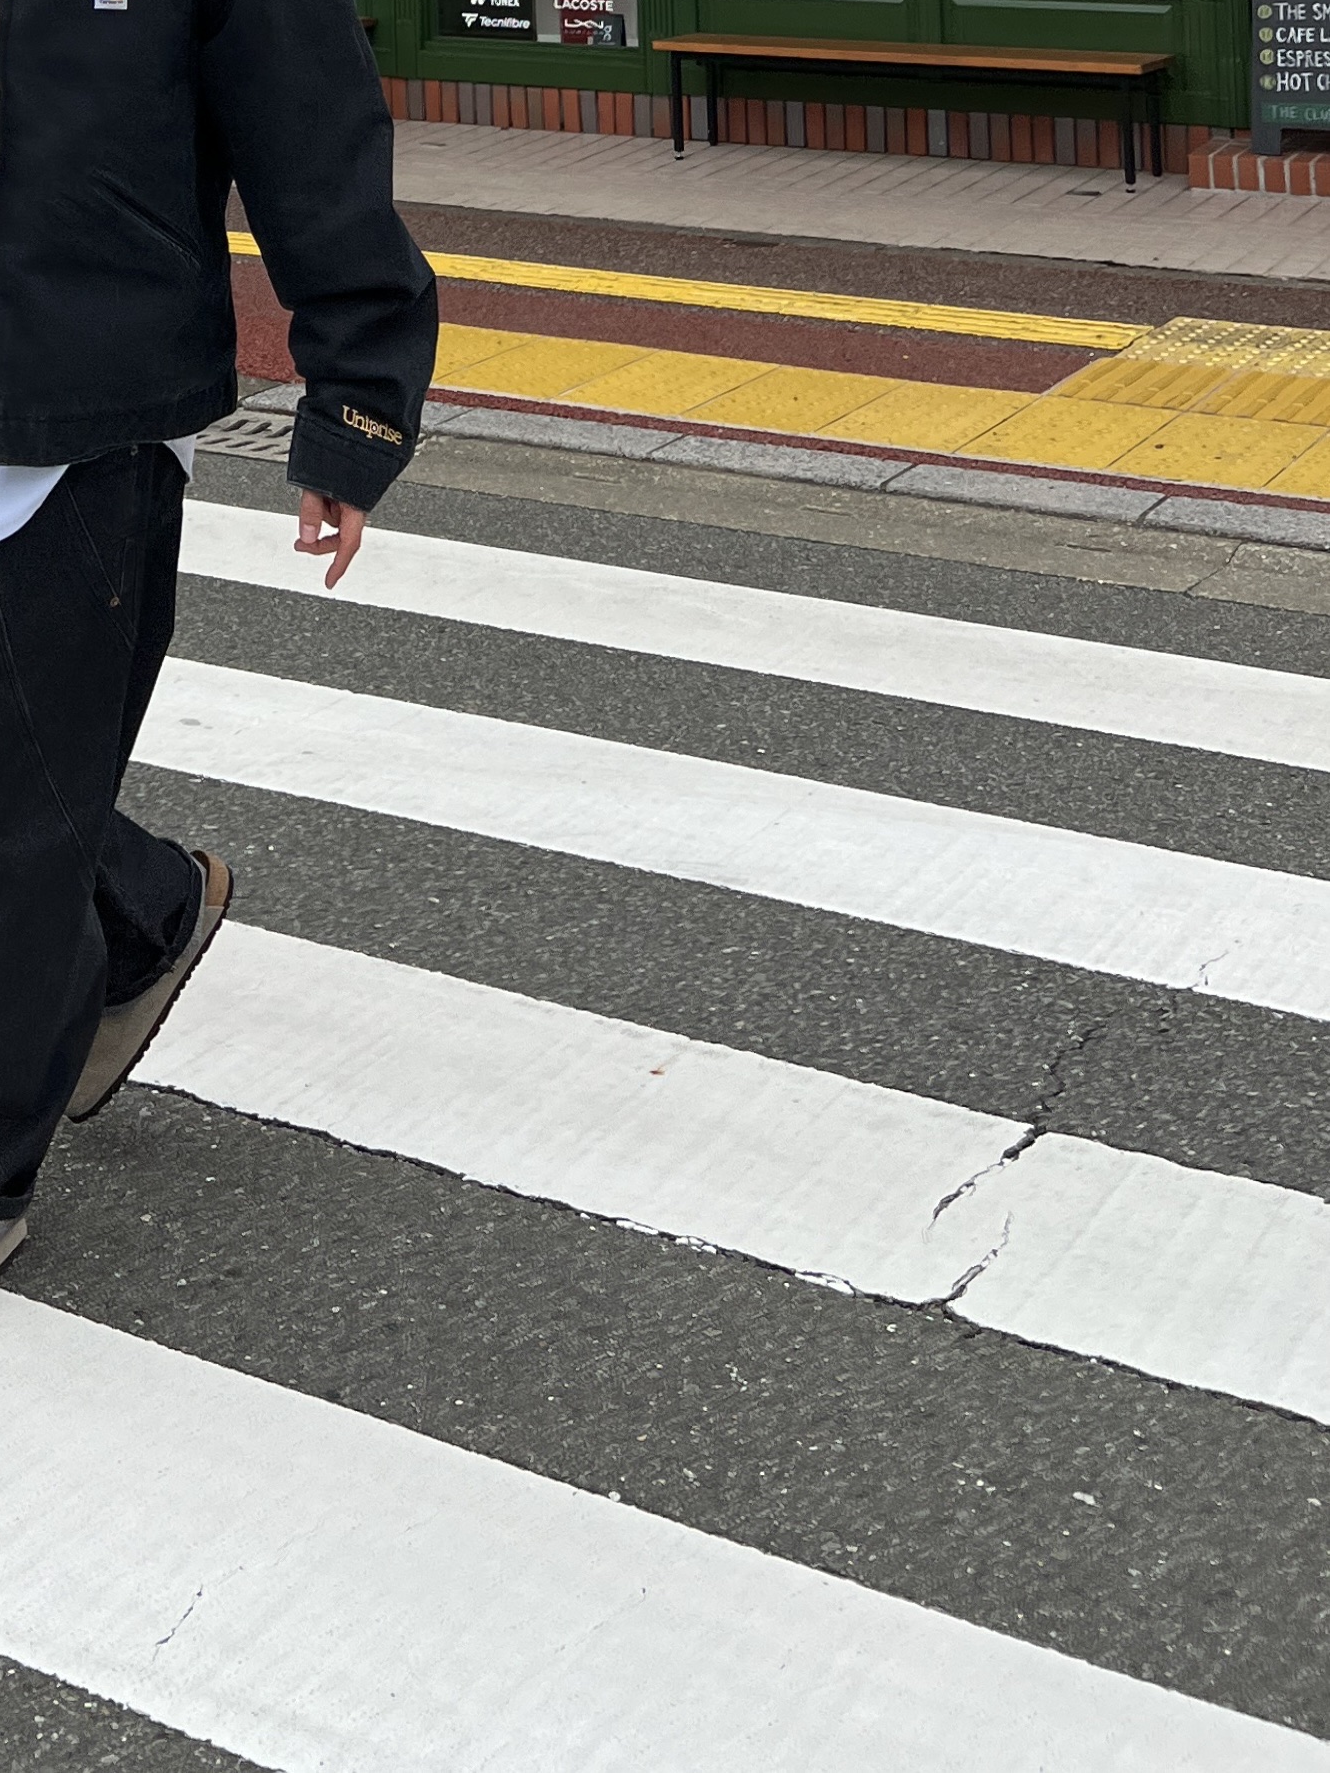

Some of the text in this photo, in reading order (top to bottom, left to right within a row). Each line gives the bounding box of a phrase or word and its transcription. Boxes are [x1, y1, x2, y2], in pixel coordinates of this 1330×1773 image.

[1272, 1, 1307, 22] THE
[479, 15, 531, 30] Tecnifibre
[1275, 27, 1316, 44] CAFE
[1276, 71, 1314, 93] HOT
[1271, 104, 1298, 120] THE
[342, 404, 403, 446] Uniprise
